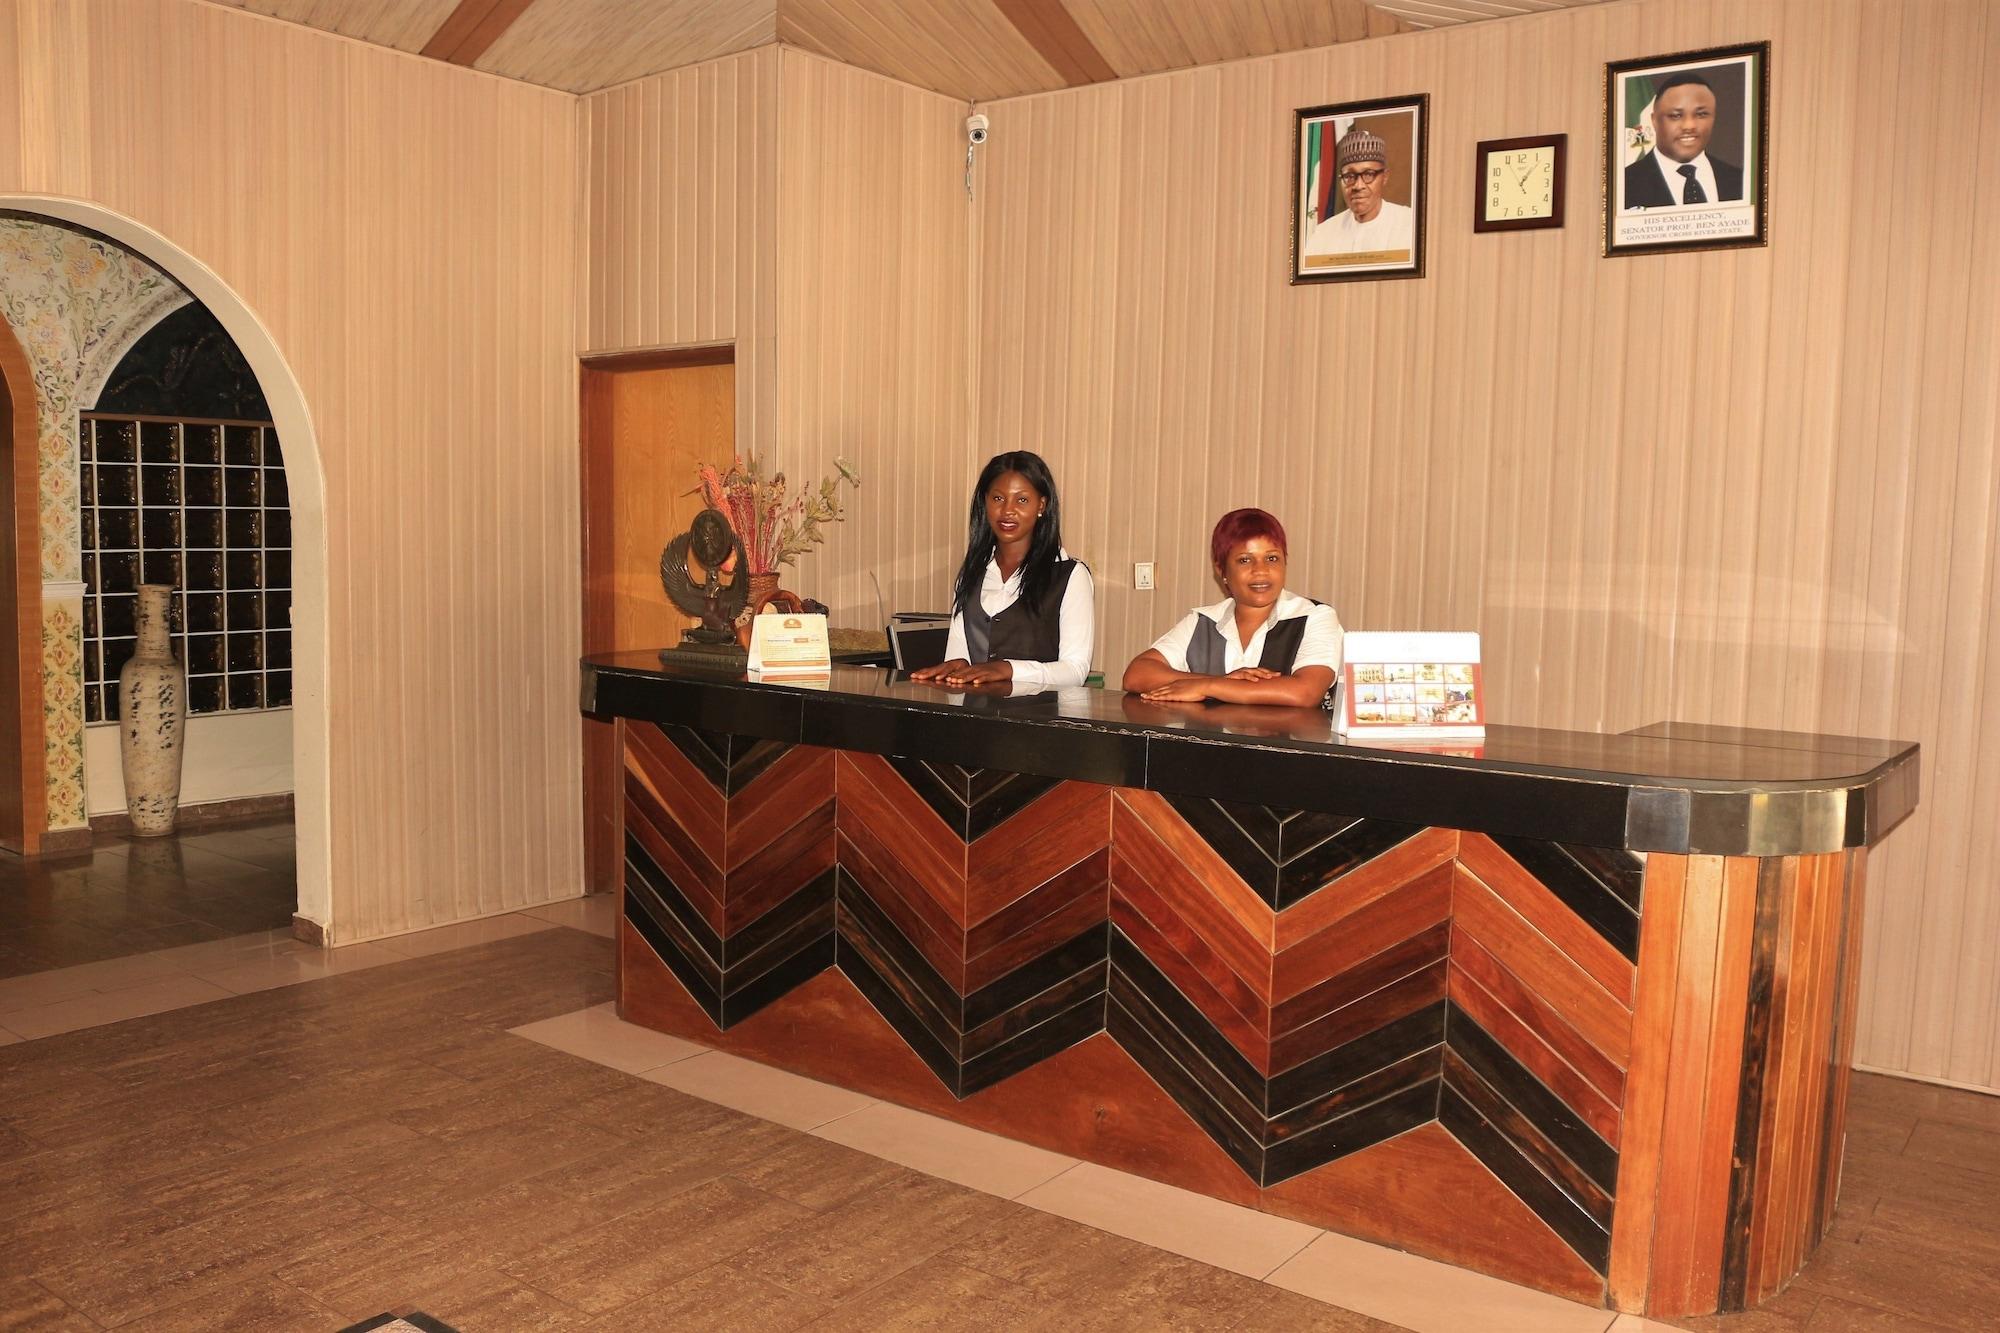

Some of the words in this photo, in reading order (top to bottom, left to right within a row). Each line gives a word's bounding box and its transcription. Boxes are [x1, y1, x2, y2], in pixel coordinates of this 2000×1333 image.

[1518, 154, 1527, 163] 12
[1493, 167, 1501, 177] 10
[1544, 163, 1550, 172] 2
[1493, 182, 1500, 192] 9
[1544, 178, 1549, 188] 3
[1493, 197, 1499, 207] 8
[1544, 193, 1549, 202] 4
[1504, 207, 1509, 217] 7
[1517, 206, 1523, 216] 6
[1532, 206, 1538, 215] 5
[1621, 225, 1665, 235] SENATOR
[1696, 221, 1715, 229] BEN
[1717, 218, 1751, 227] AYADE
